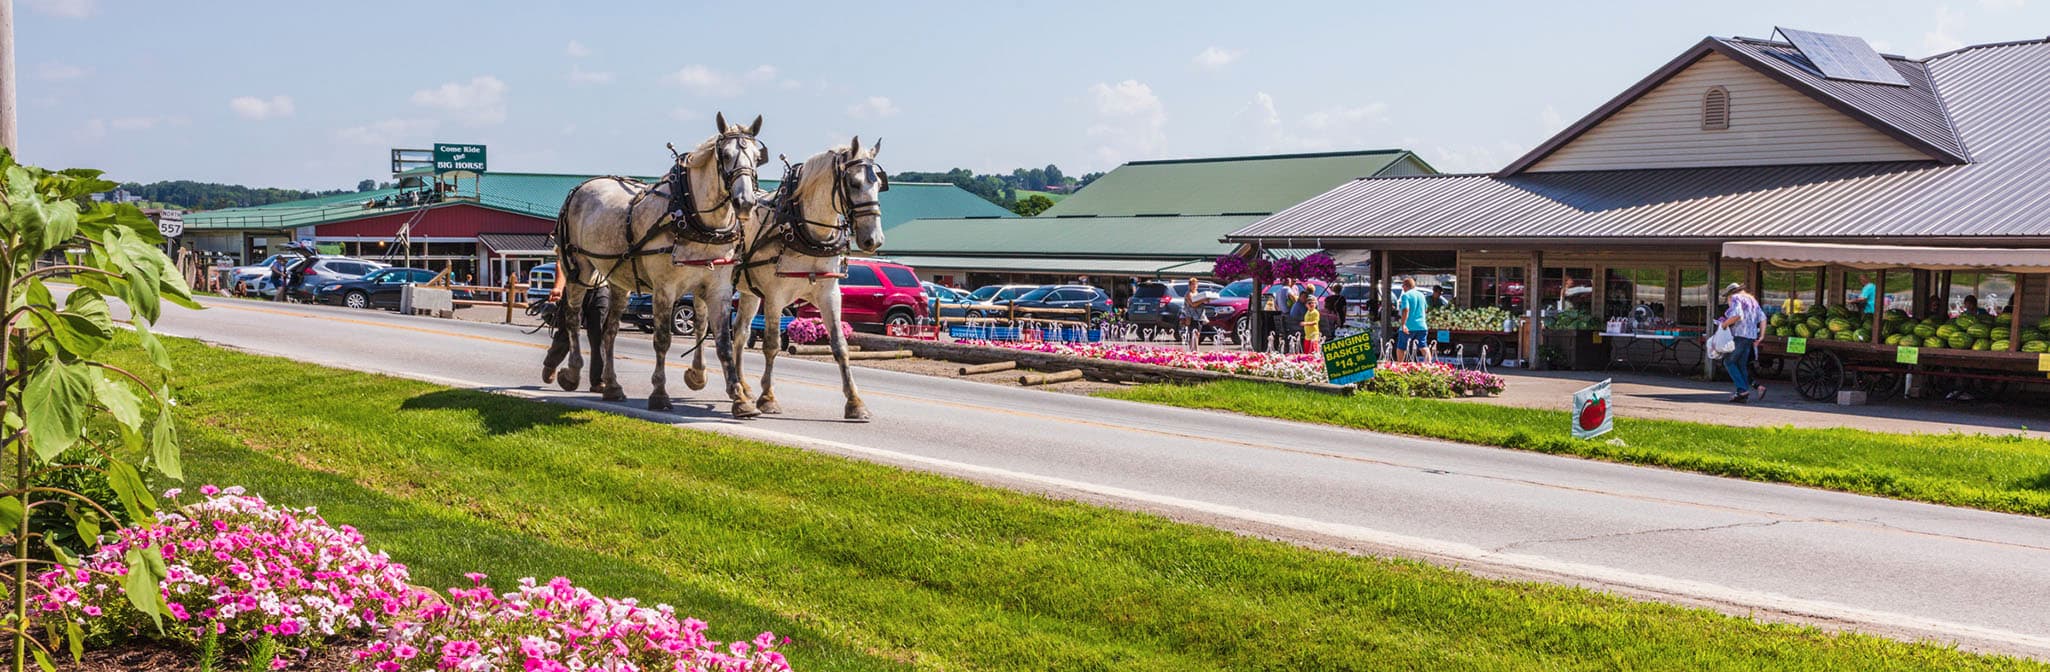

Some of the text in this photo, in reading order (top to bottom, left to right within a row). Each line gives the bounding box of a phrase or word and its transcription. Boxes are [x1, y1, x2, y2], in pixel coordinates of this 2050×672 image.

[440, 145, 462, 153] Come
[453, 153, 465, 161] the
[437, 161, 484, 169] BIG HORSE
[161, 223, 181, 233] 557
[1323, 333, 1370, 353] HANGING
[1325, 342, 1371, 361] BASKETS
